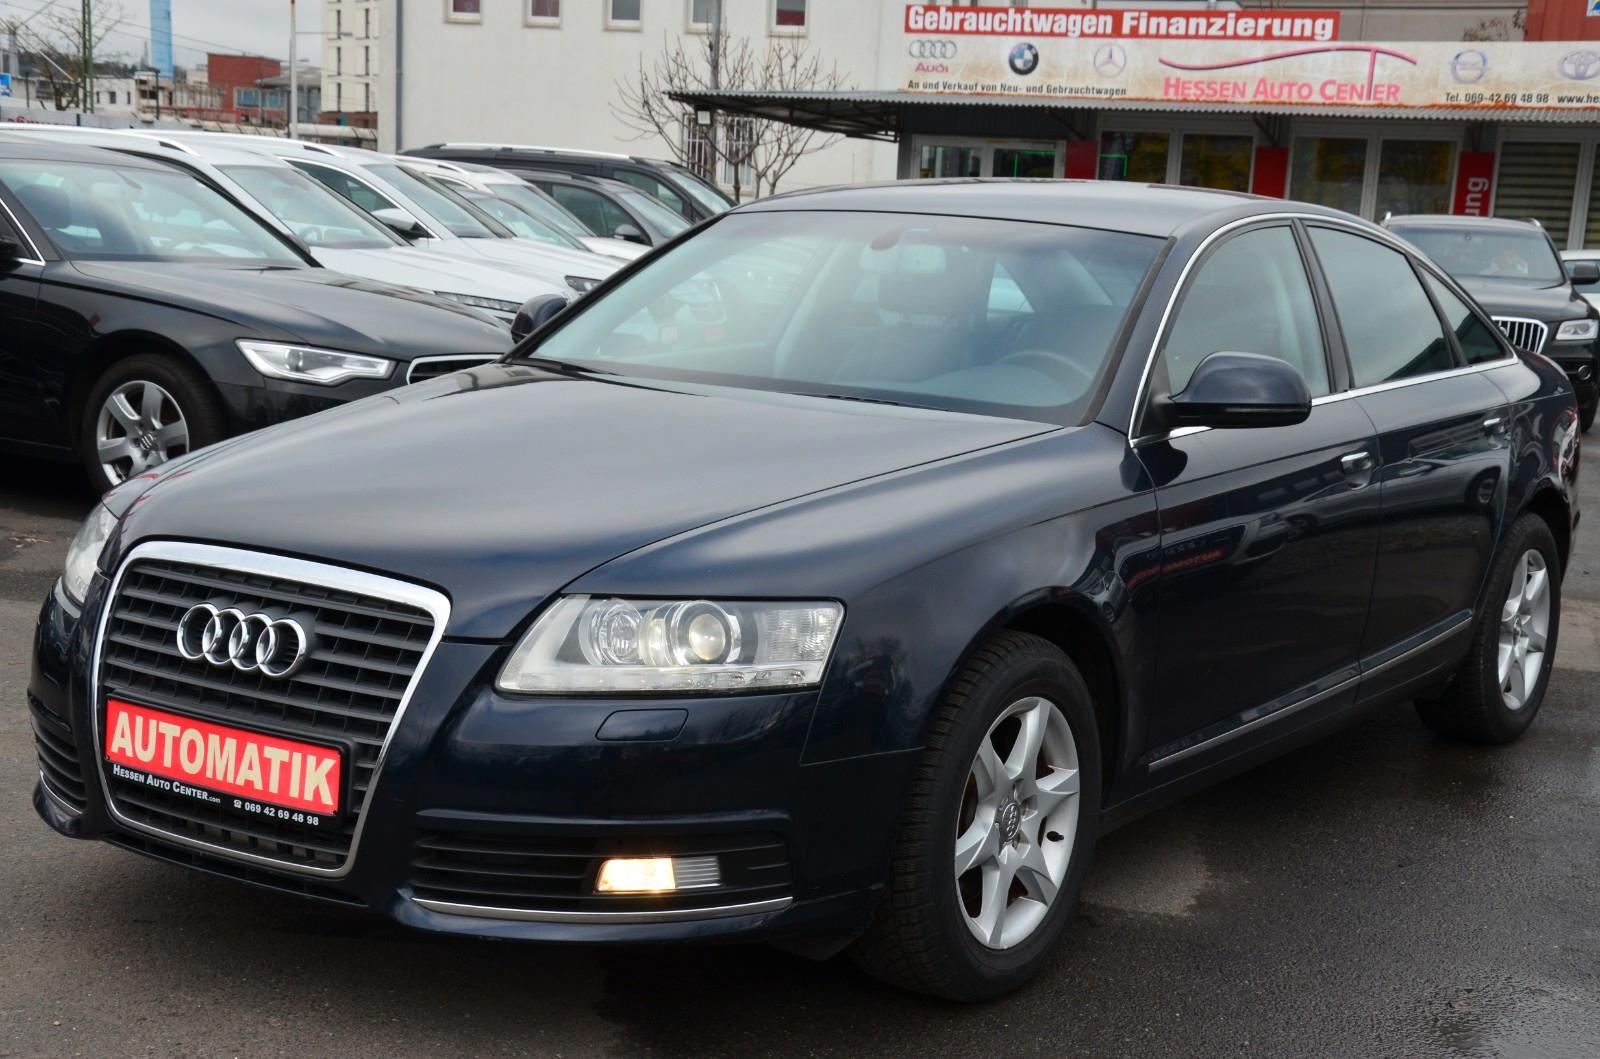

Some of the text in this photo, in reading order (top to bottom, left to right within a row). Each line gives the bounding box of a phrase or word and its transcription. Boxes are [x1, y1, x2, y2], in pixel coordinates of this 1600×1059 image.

[908, 5, 1335, 41] Gebrauchtwagen Finanzierung
[908, 80, 920, 89] An
[922, 81, 940, 90] und
[942, 81, 978, 91] Verkauf
[980, 84, 997, 92] von
[1026, 84, 1044, 93] und
[1046, 84, 1127, 97] Gebrauchtwagen
[1445, 93, 1461, 103] Tel.
[1520, 93, 1533, 104] 48
[1535, 93, 1549, 104] 98
[110, 710, 337, 806] AUTOMATIK
[113, 763, 145, 783] HESSEN
[146, 773, 171, 791] AUTO
[244, 801, 261, 814] 069
[263, 806, 276, 817] 42
[277, 809, 289, 820] 69
[291, 812, 304, 823] 48
[306, 814, 319, 826] 98
